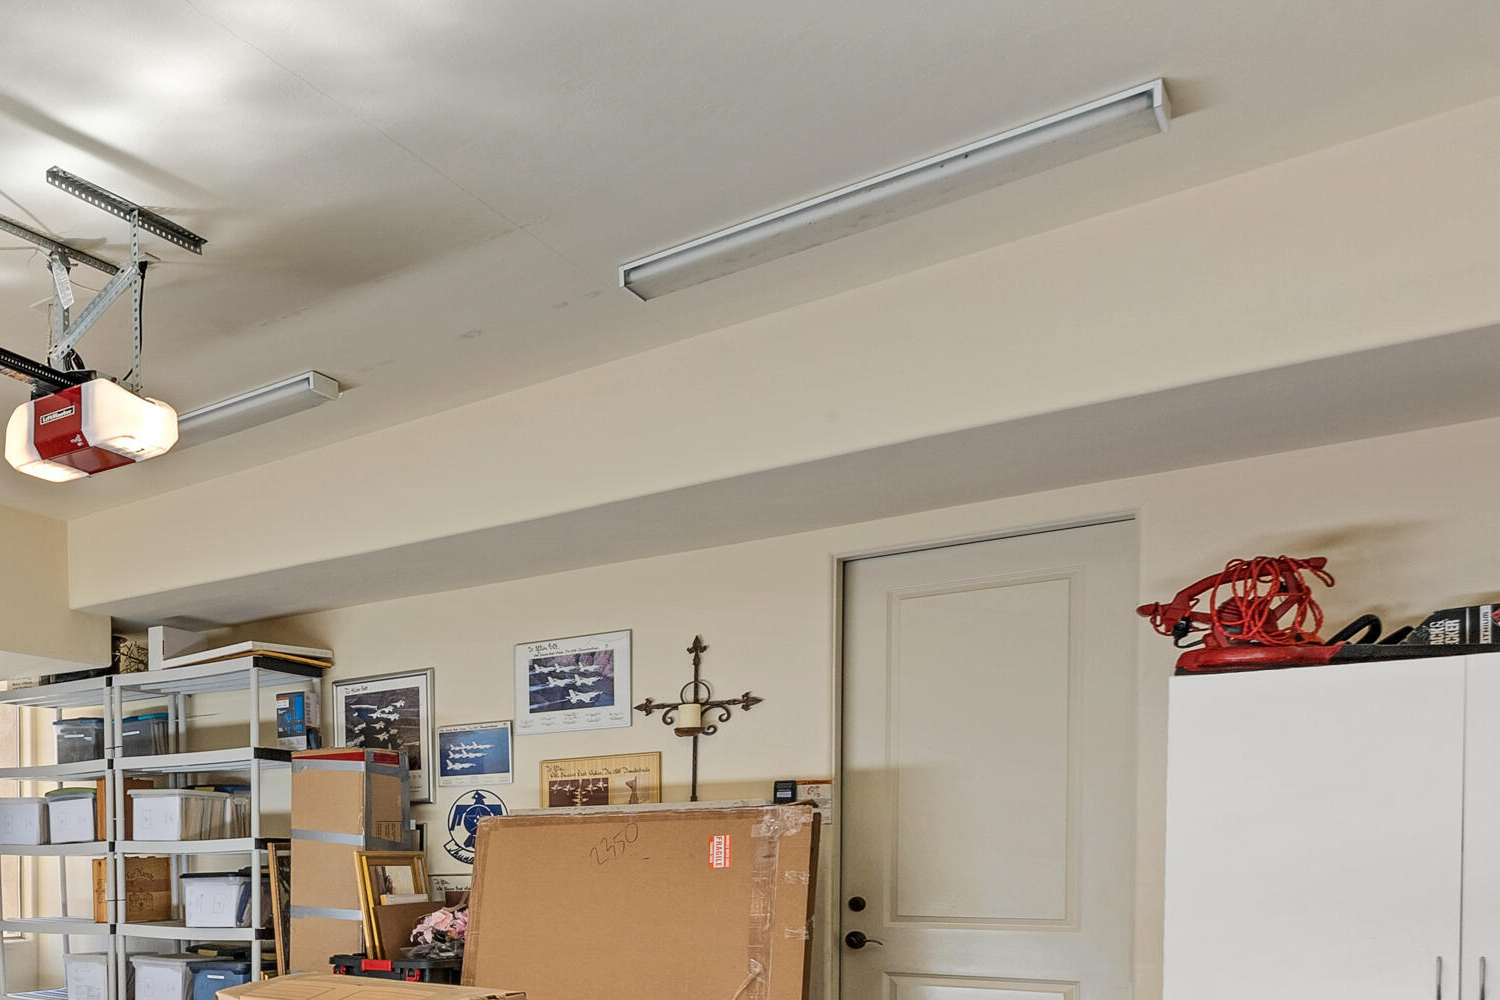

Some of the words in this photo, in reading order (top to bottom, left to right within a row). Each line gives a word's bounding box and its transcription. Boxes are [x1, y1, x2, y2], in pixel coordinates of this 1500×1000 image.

[1429, 620, 1445, 645] ACK&
[1444, 619, 1460, 645] CKER
[1482, 611, 1490, 644] ITHIUM
[715, 836, 724, 867] FRAGILE
